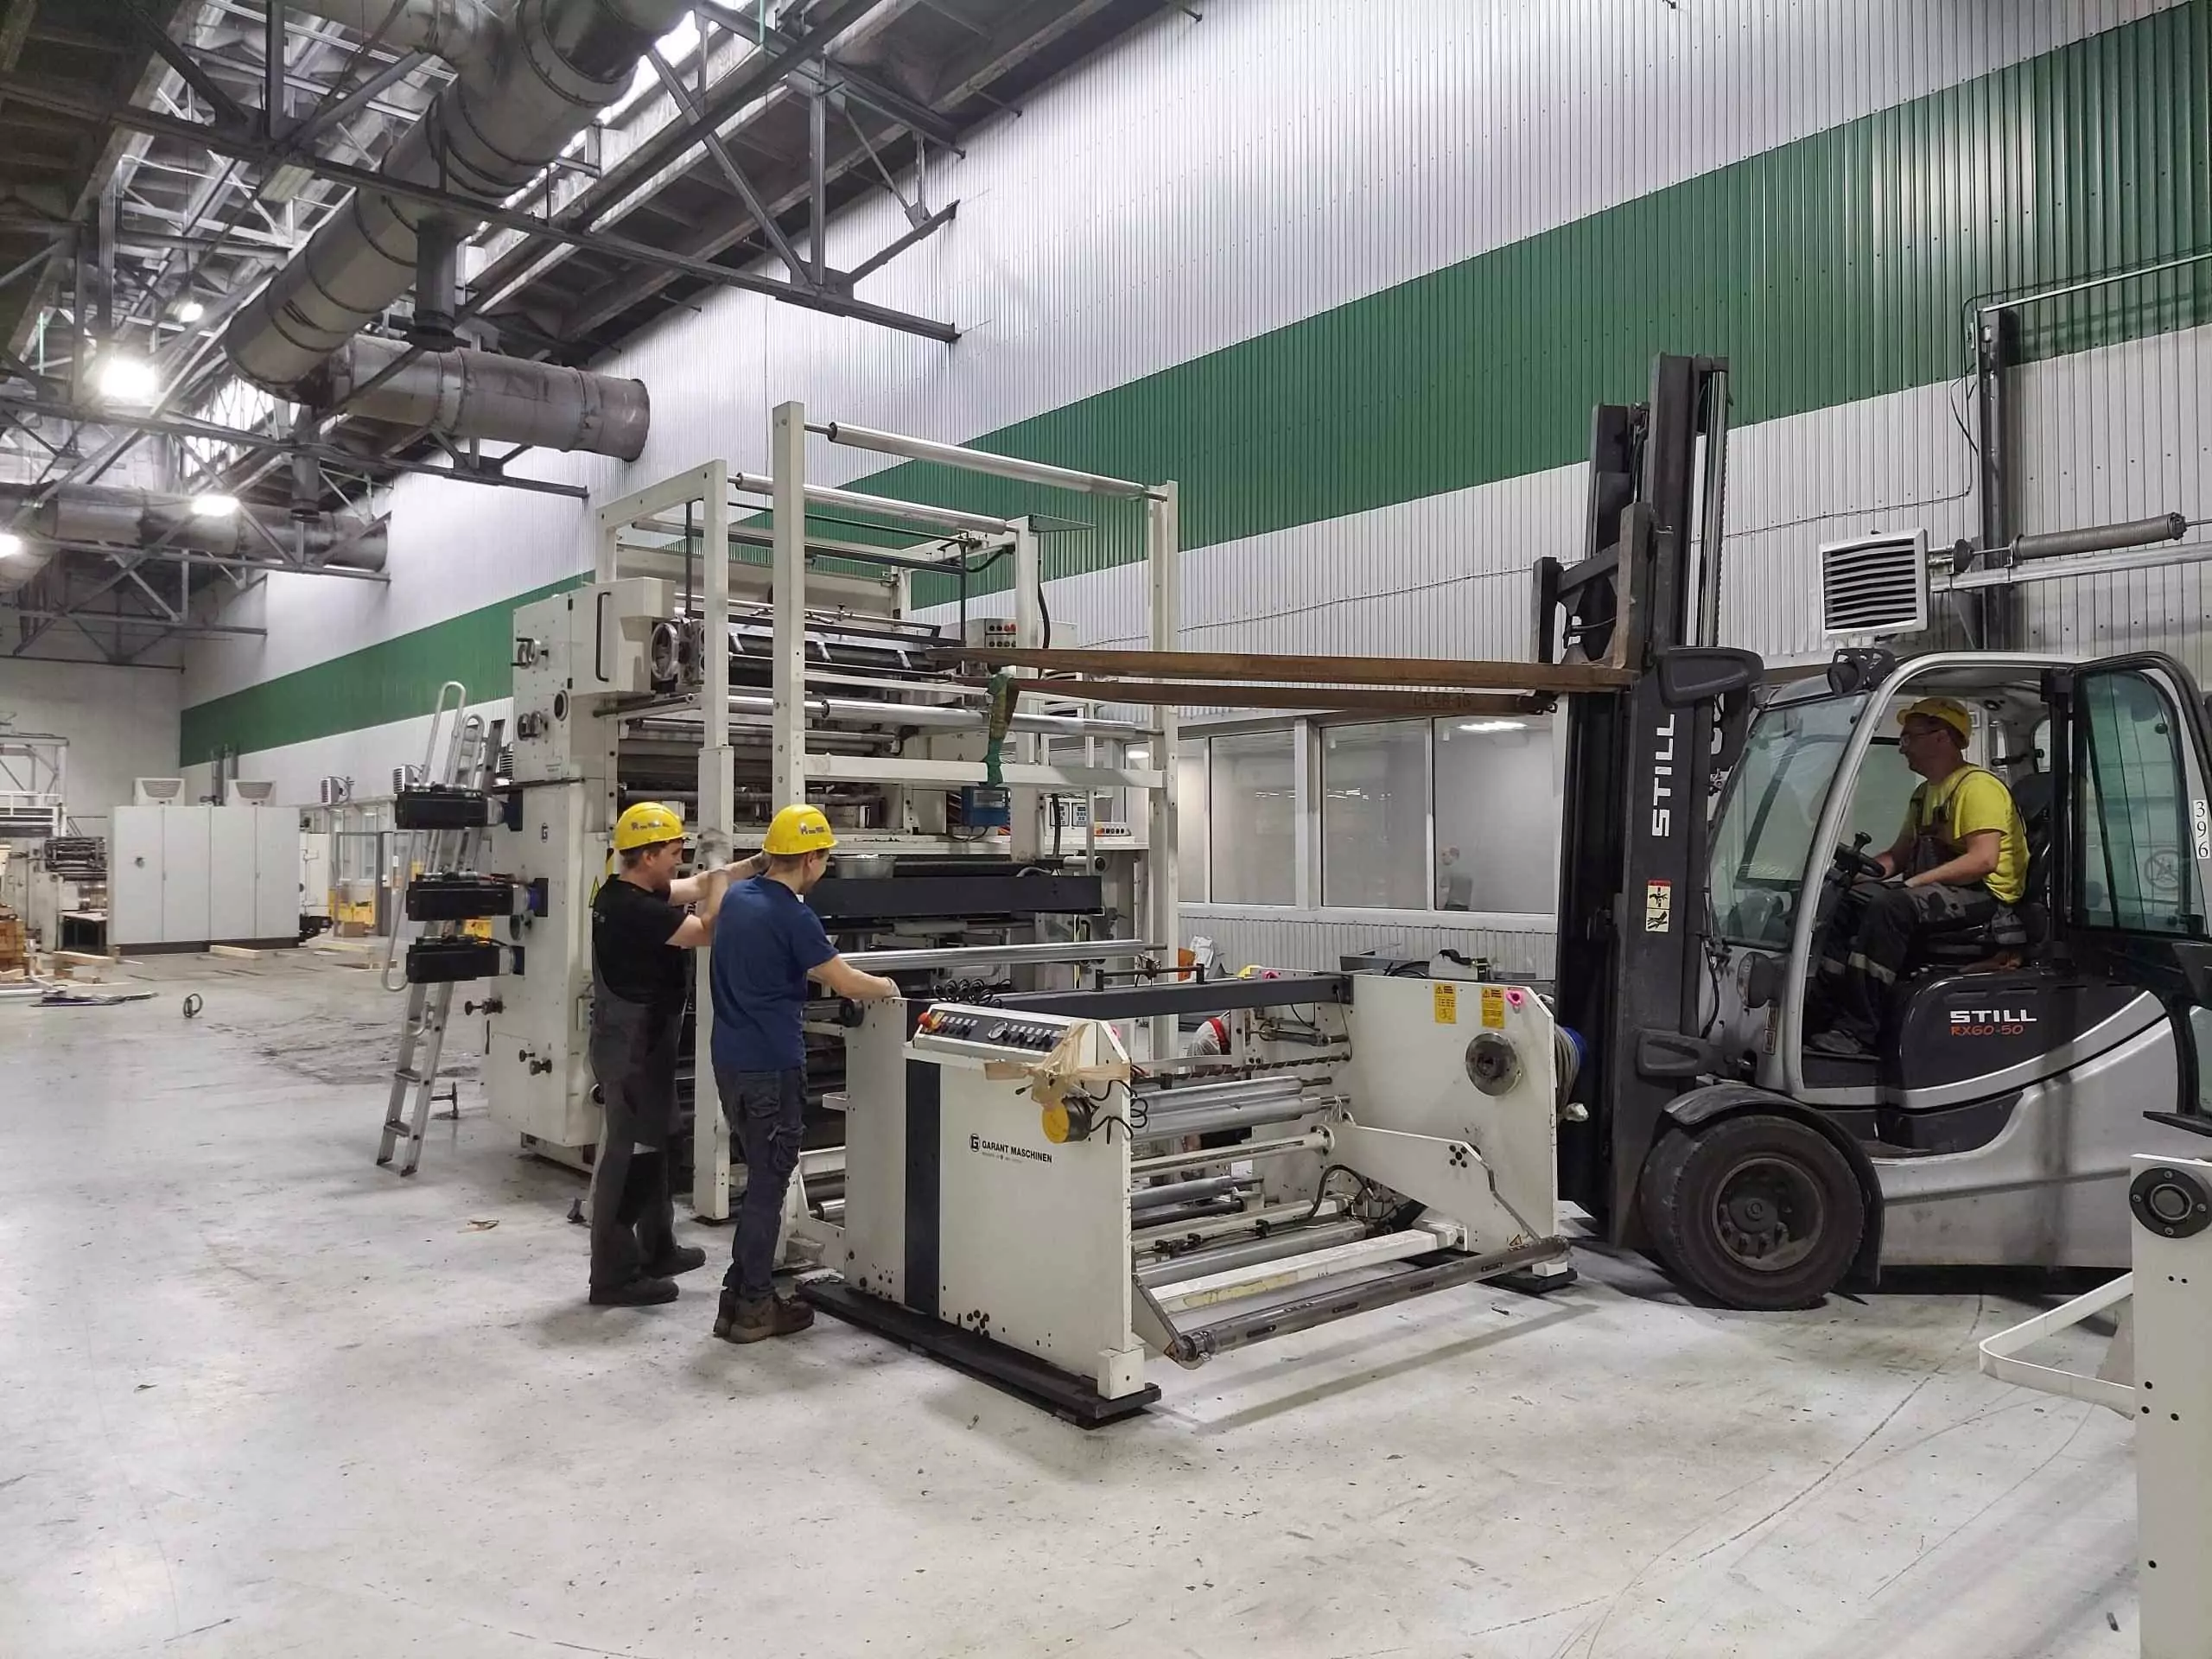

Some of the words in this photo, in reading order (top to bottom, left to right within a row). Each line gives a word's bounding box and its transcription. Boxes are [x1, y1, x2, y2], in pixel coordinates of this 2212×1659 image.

[1651, 713, 1675, 836] STILL
[2196, 801, 2209, 858] 396
[1950, 1009, 2037, 1023] STILL
[982, 1141, 1009, 1154] GARANT
[1010, 1147, 1052, 1163] MASCHINEN
